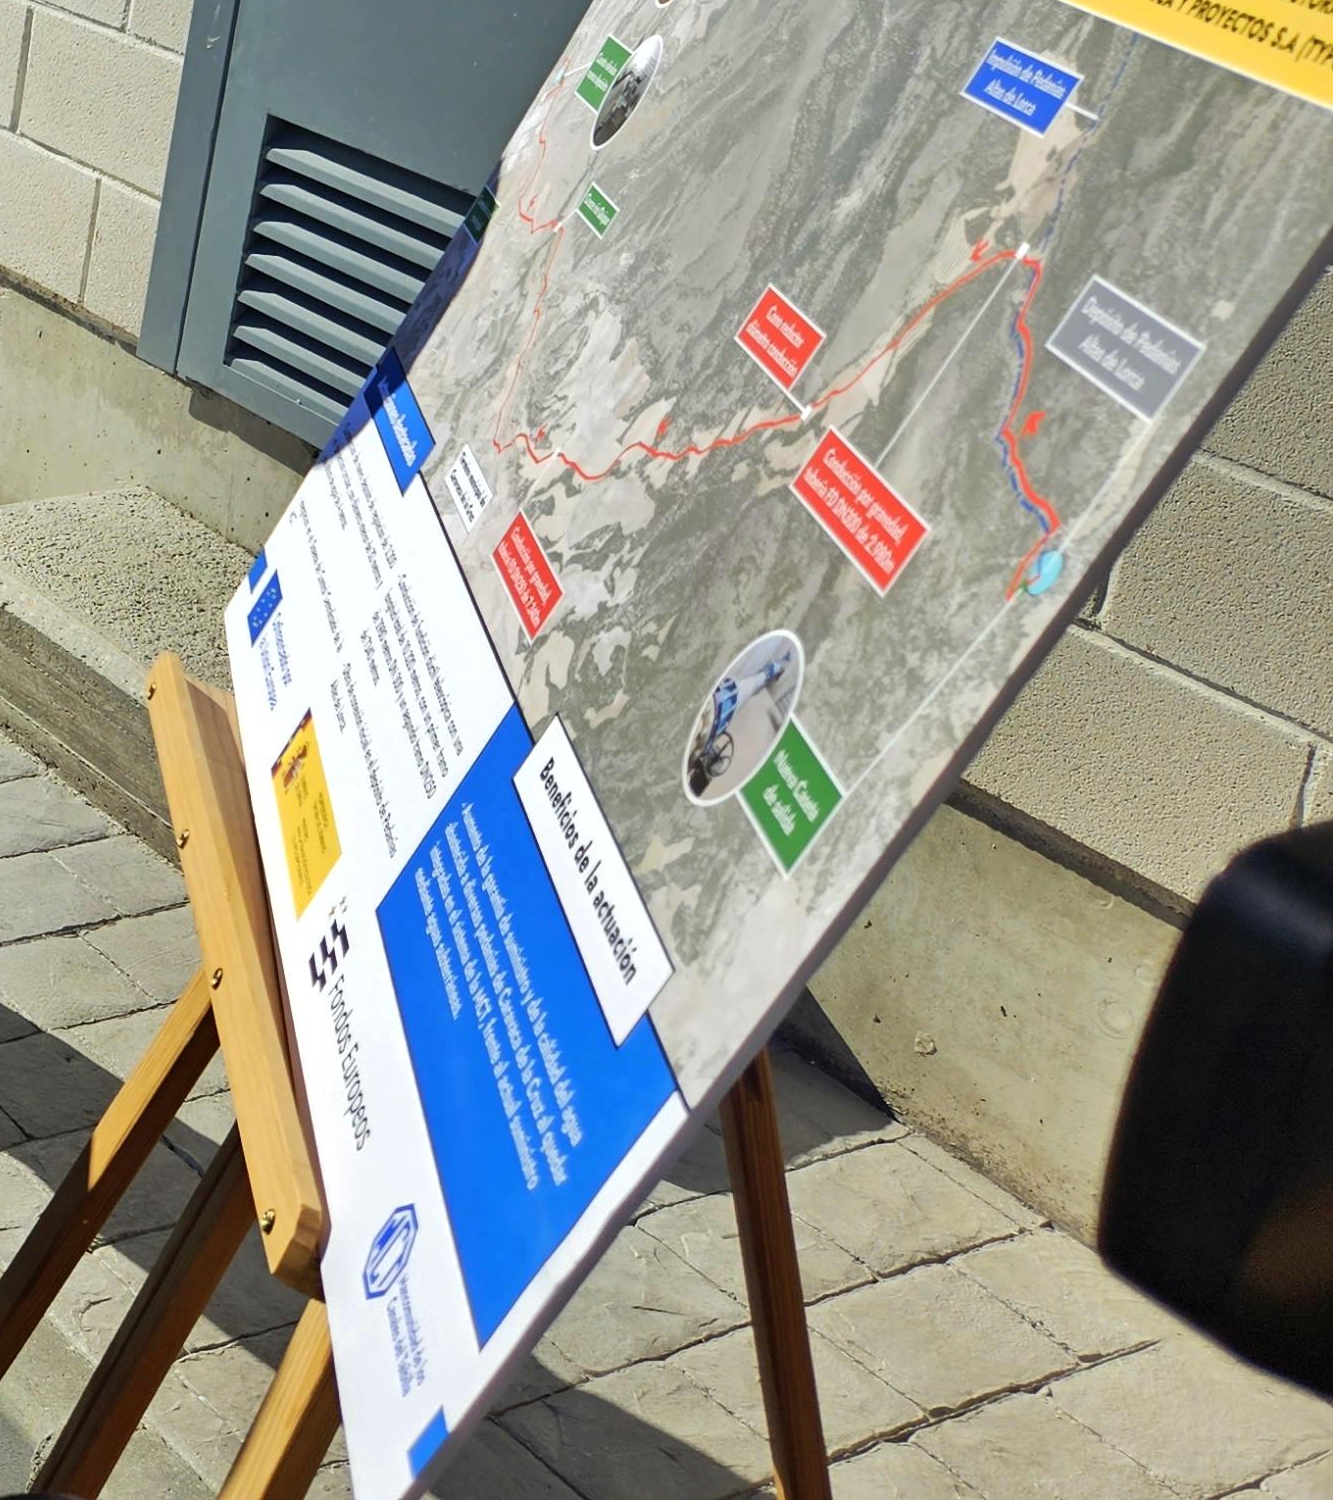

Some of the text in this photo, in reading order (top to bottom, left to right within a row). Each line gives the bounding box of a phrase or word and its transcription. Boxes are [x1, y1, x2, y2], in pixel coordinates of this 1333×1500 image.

[1296, 35, 1333, 72] (TYP
[1017, 64, 1034, 83] de
[1028, 69, 1066, 99] Pedanías
[822, 447, 862, 496] Conducción
[854, 488, 874, 508] por
[429, 840, 451, 900] integradas
[475, 844, 489, 867] de
[480, 855, 492, 878] la
[539, 756, 637, 985] Beneficios de la actuación
[414, 867, 433, 916] mediante
[425, 911, 442, 948] aguas
[444, 894, 455, 914] en
[480, 871, 507, 920] garantía
[448, 909, 462, 925] el
[498, 912, 512, 936] de
[451, 920, 470, 965] sistema
[503, 930, 530, 994] suministro
[463, 958, 477, 982] de
[468, 971, 481, 995] la
[444, 821, 567, 1186] abastecida a diversas pedanías de Caravaca de la Cruz al quedar
[520, 988, 534, 1005] y
[526, 997, 542, 1022] de
[482, 1017, 501, 1065] frente
[532, 1011, 547, 1037] la
[328, 973, 371, 1151] Fondos Europeos
[492, 1060, 509, 1079] al
[537, 1030, 566, 1085] calidad
[497, 1074, 521, 1119] actual
[553, 1078, 574, 1109] del
[560, 1104, 582, 1147] agua
[508, 1113, 539, 1190] suministro
